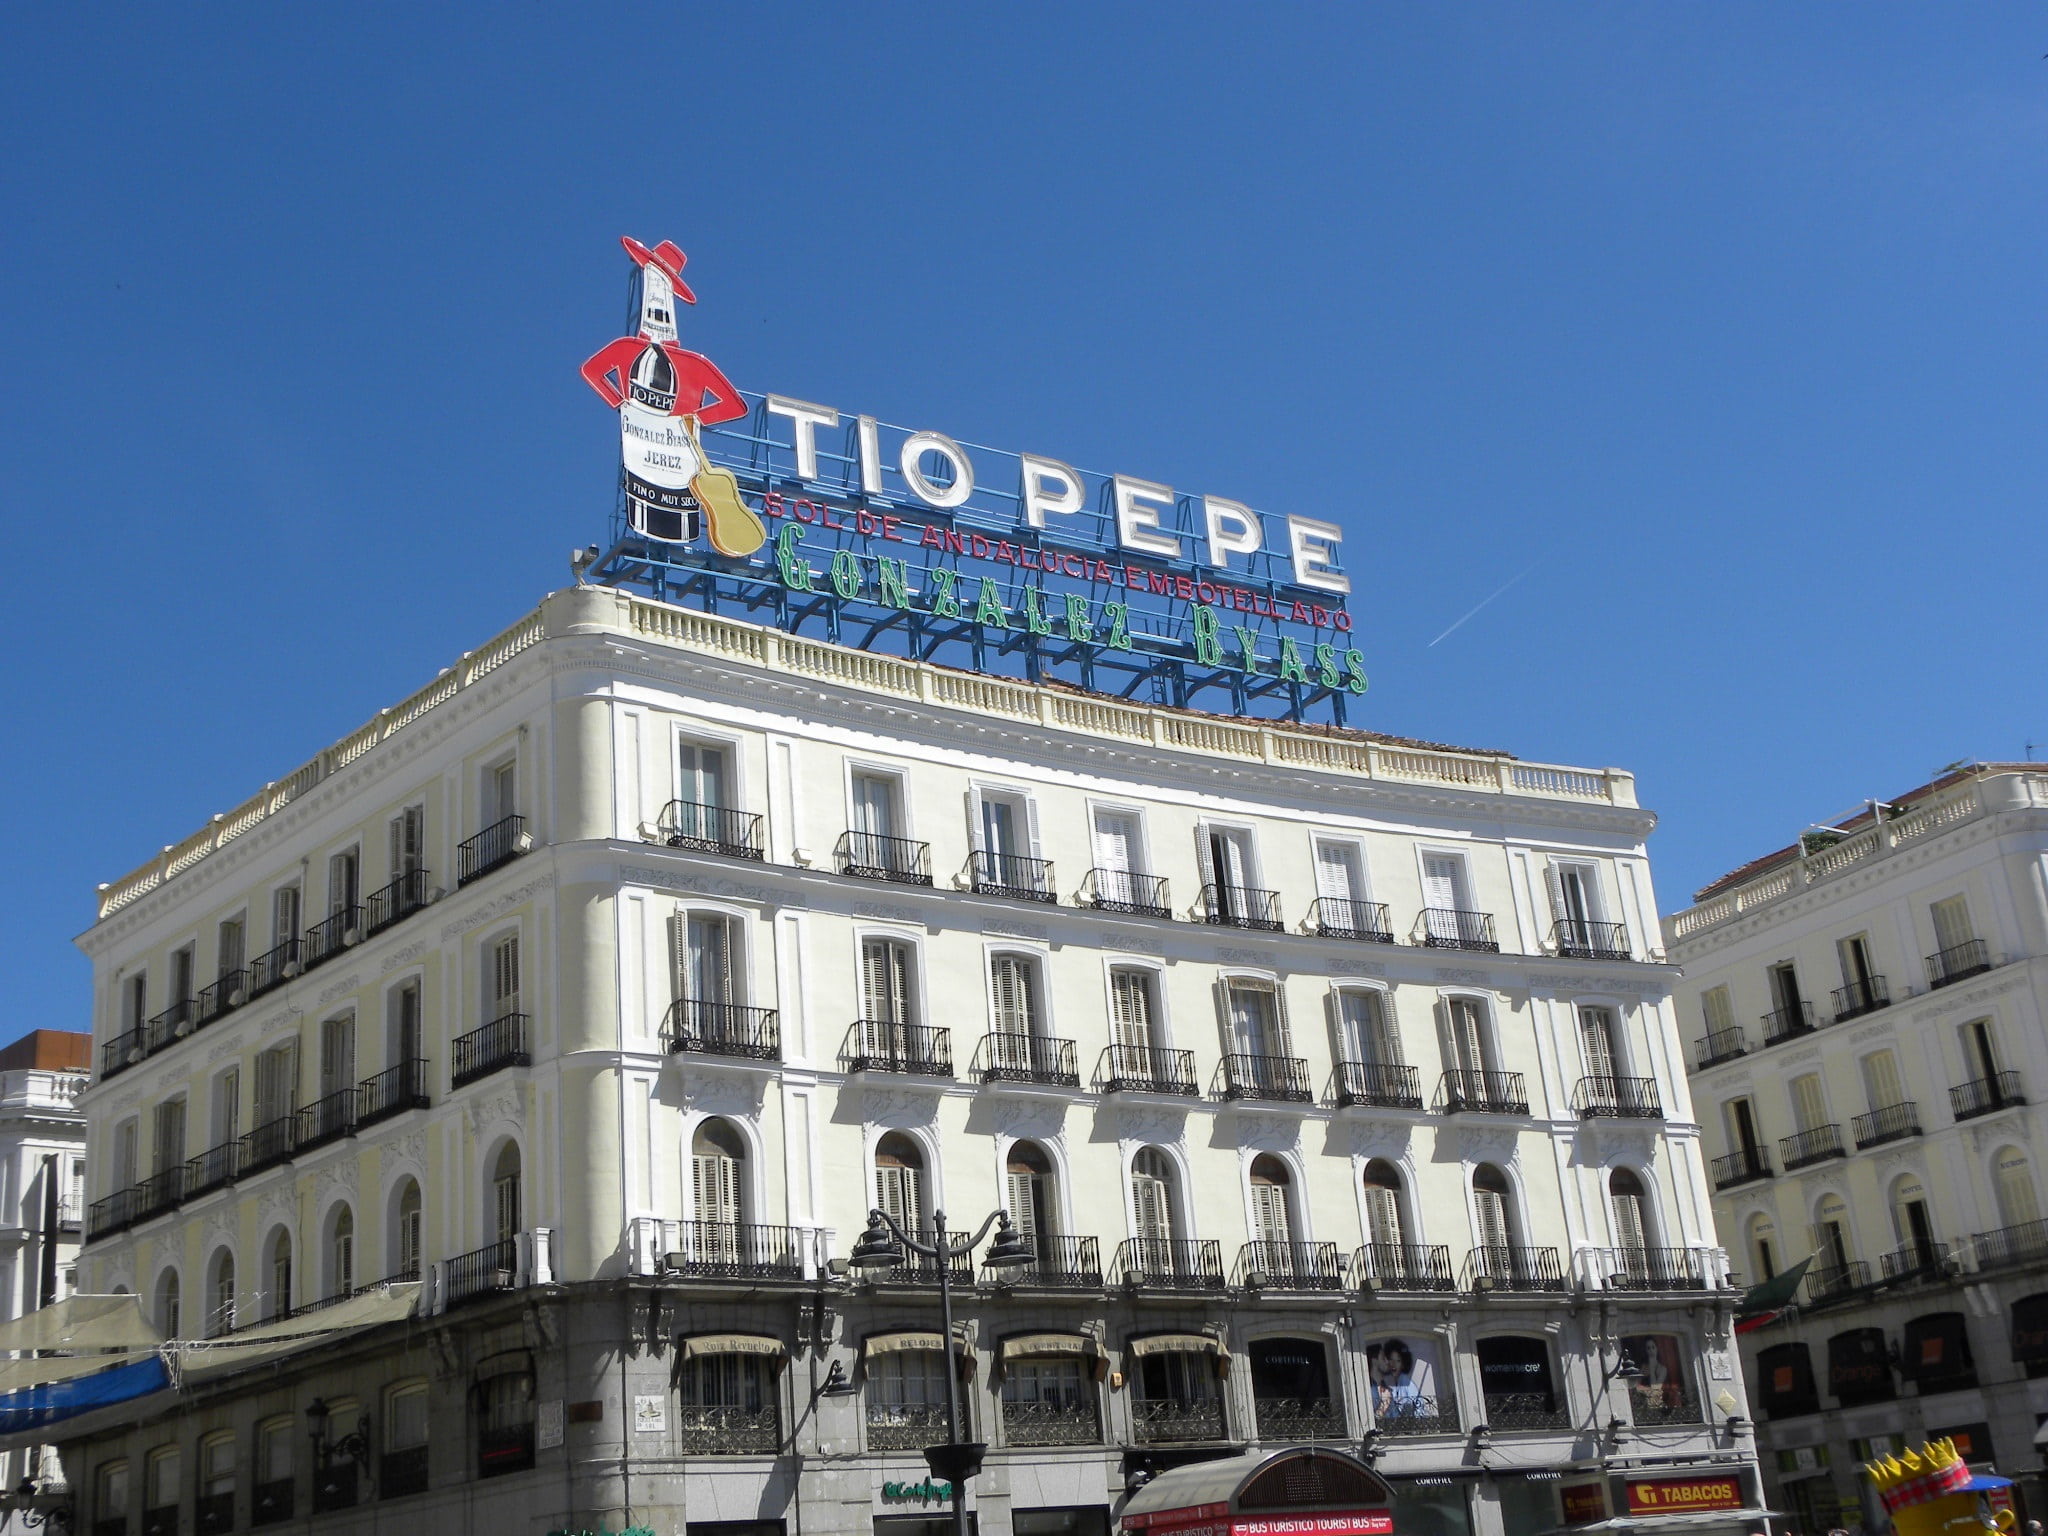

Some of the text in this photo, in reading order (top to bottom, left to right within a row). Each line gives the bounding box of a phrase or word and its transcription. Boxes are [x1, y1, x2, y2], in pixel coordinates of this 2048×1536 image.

[644, 450, 682, 470] JEREZ
[633, 482, 656, 499] FINO
[660, 493, 679, 505] MUY
[766, 393, 1351, 594] TIO PEPE
[764, 492, 1353, 632] SOL DE ANDALUCIA EMBOTELLADO
[776, 522, 1369, 694] GONZALEZ BYASS
[900, 1339, 942, 1348] RELOJES
[1662, 1484, 1733, 1503] TABACOS
[1249, 1521, 1268, 1534] BUS
[1315, 1518, 1352, 1531] TOURIST
[1352, 1516, 1370, 1529] BUS
